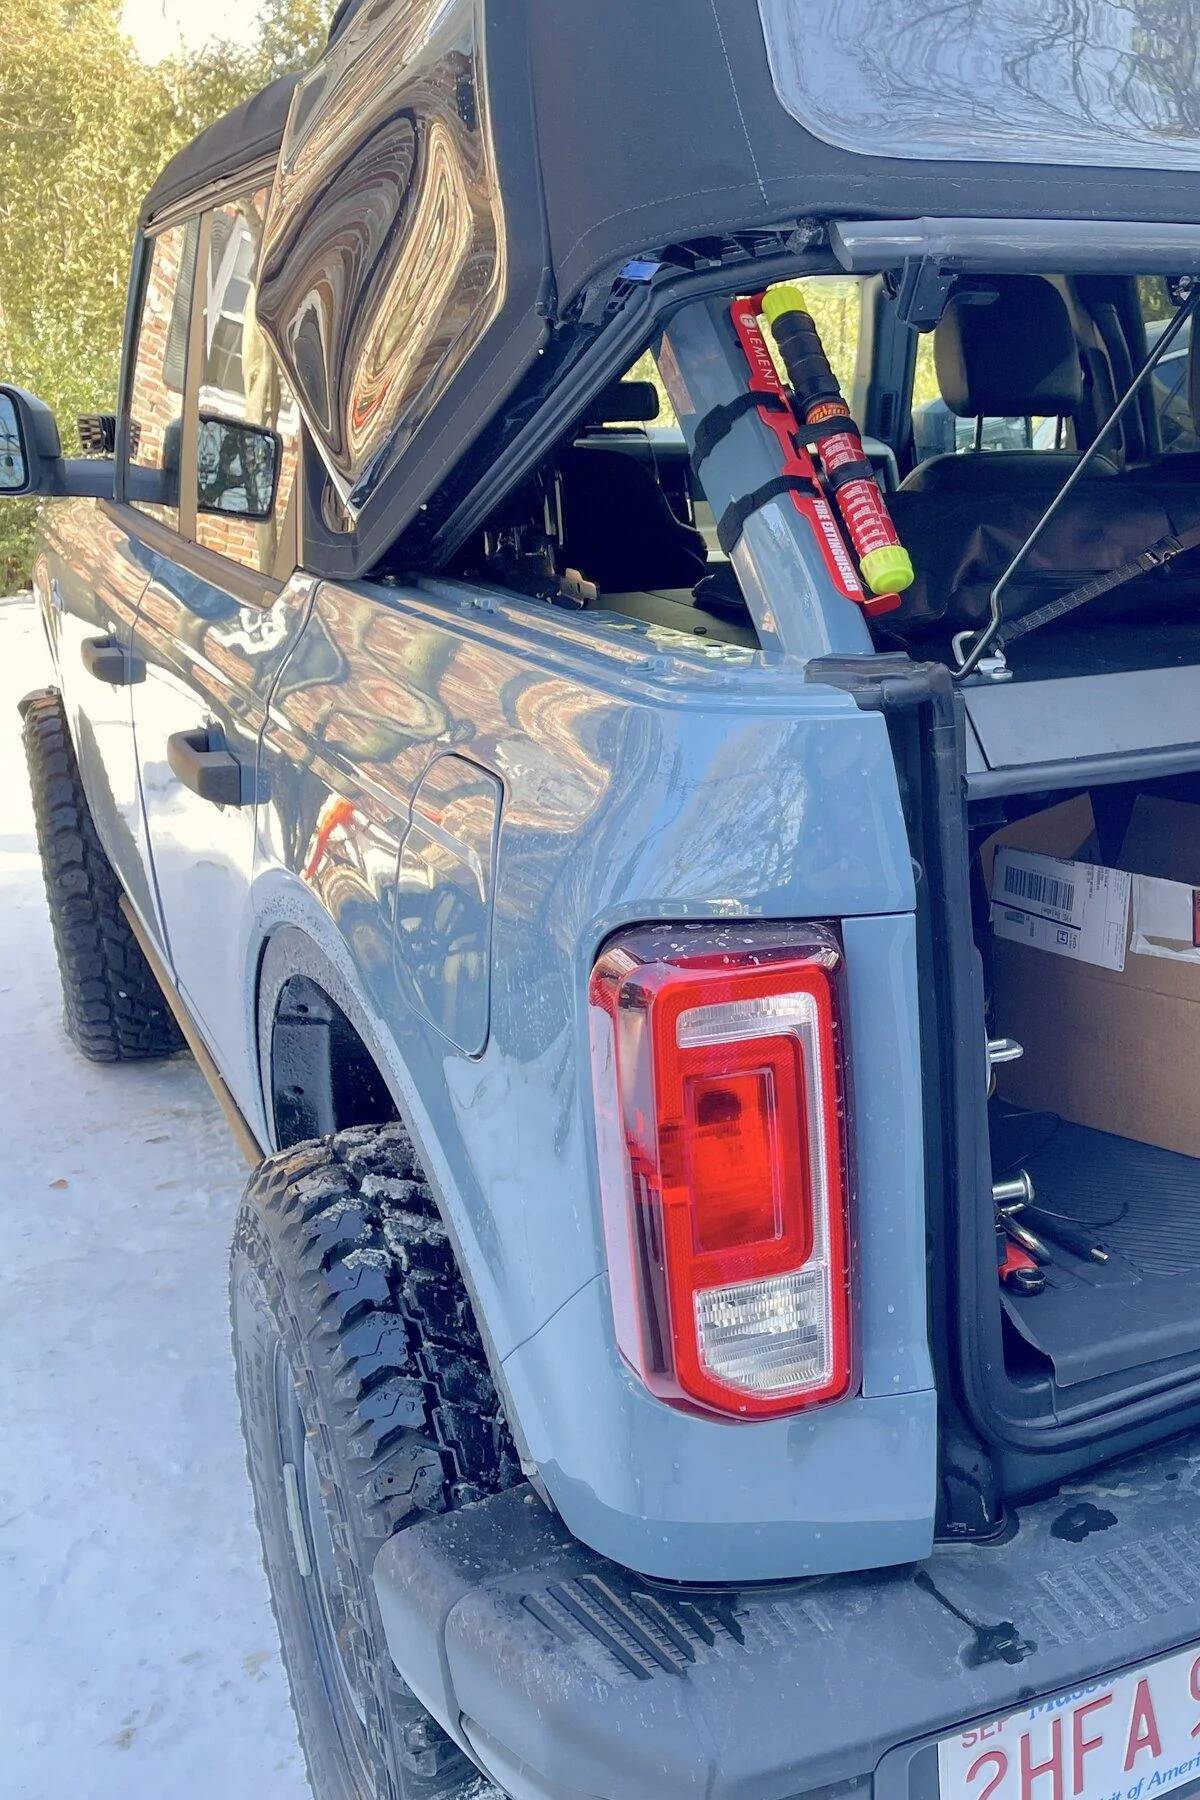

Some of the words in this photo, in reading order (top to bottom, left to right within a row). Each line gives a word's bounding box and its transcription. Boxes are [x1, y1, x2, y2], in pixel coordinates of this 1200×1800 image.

[740, 313, 779, 388] ELEMENT
[812, 499, 831, 520] FIRE
[821, 521, 859, 591] EXTINGUISHER
[1127, 1777, 1145, 1799] of
